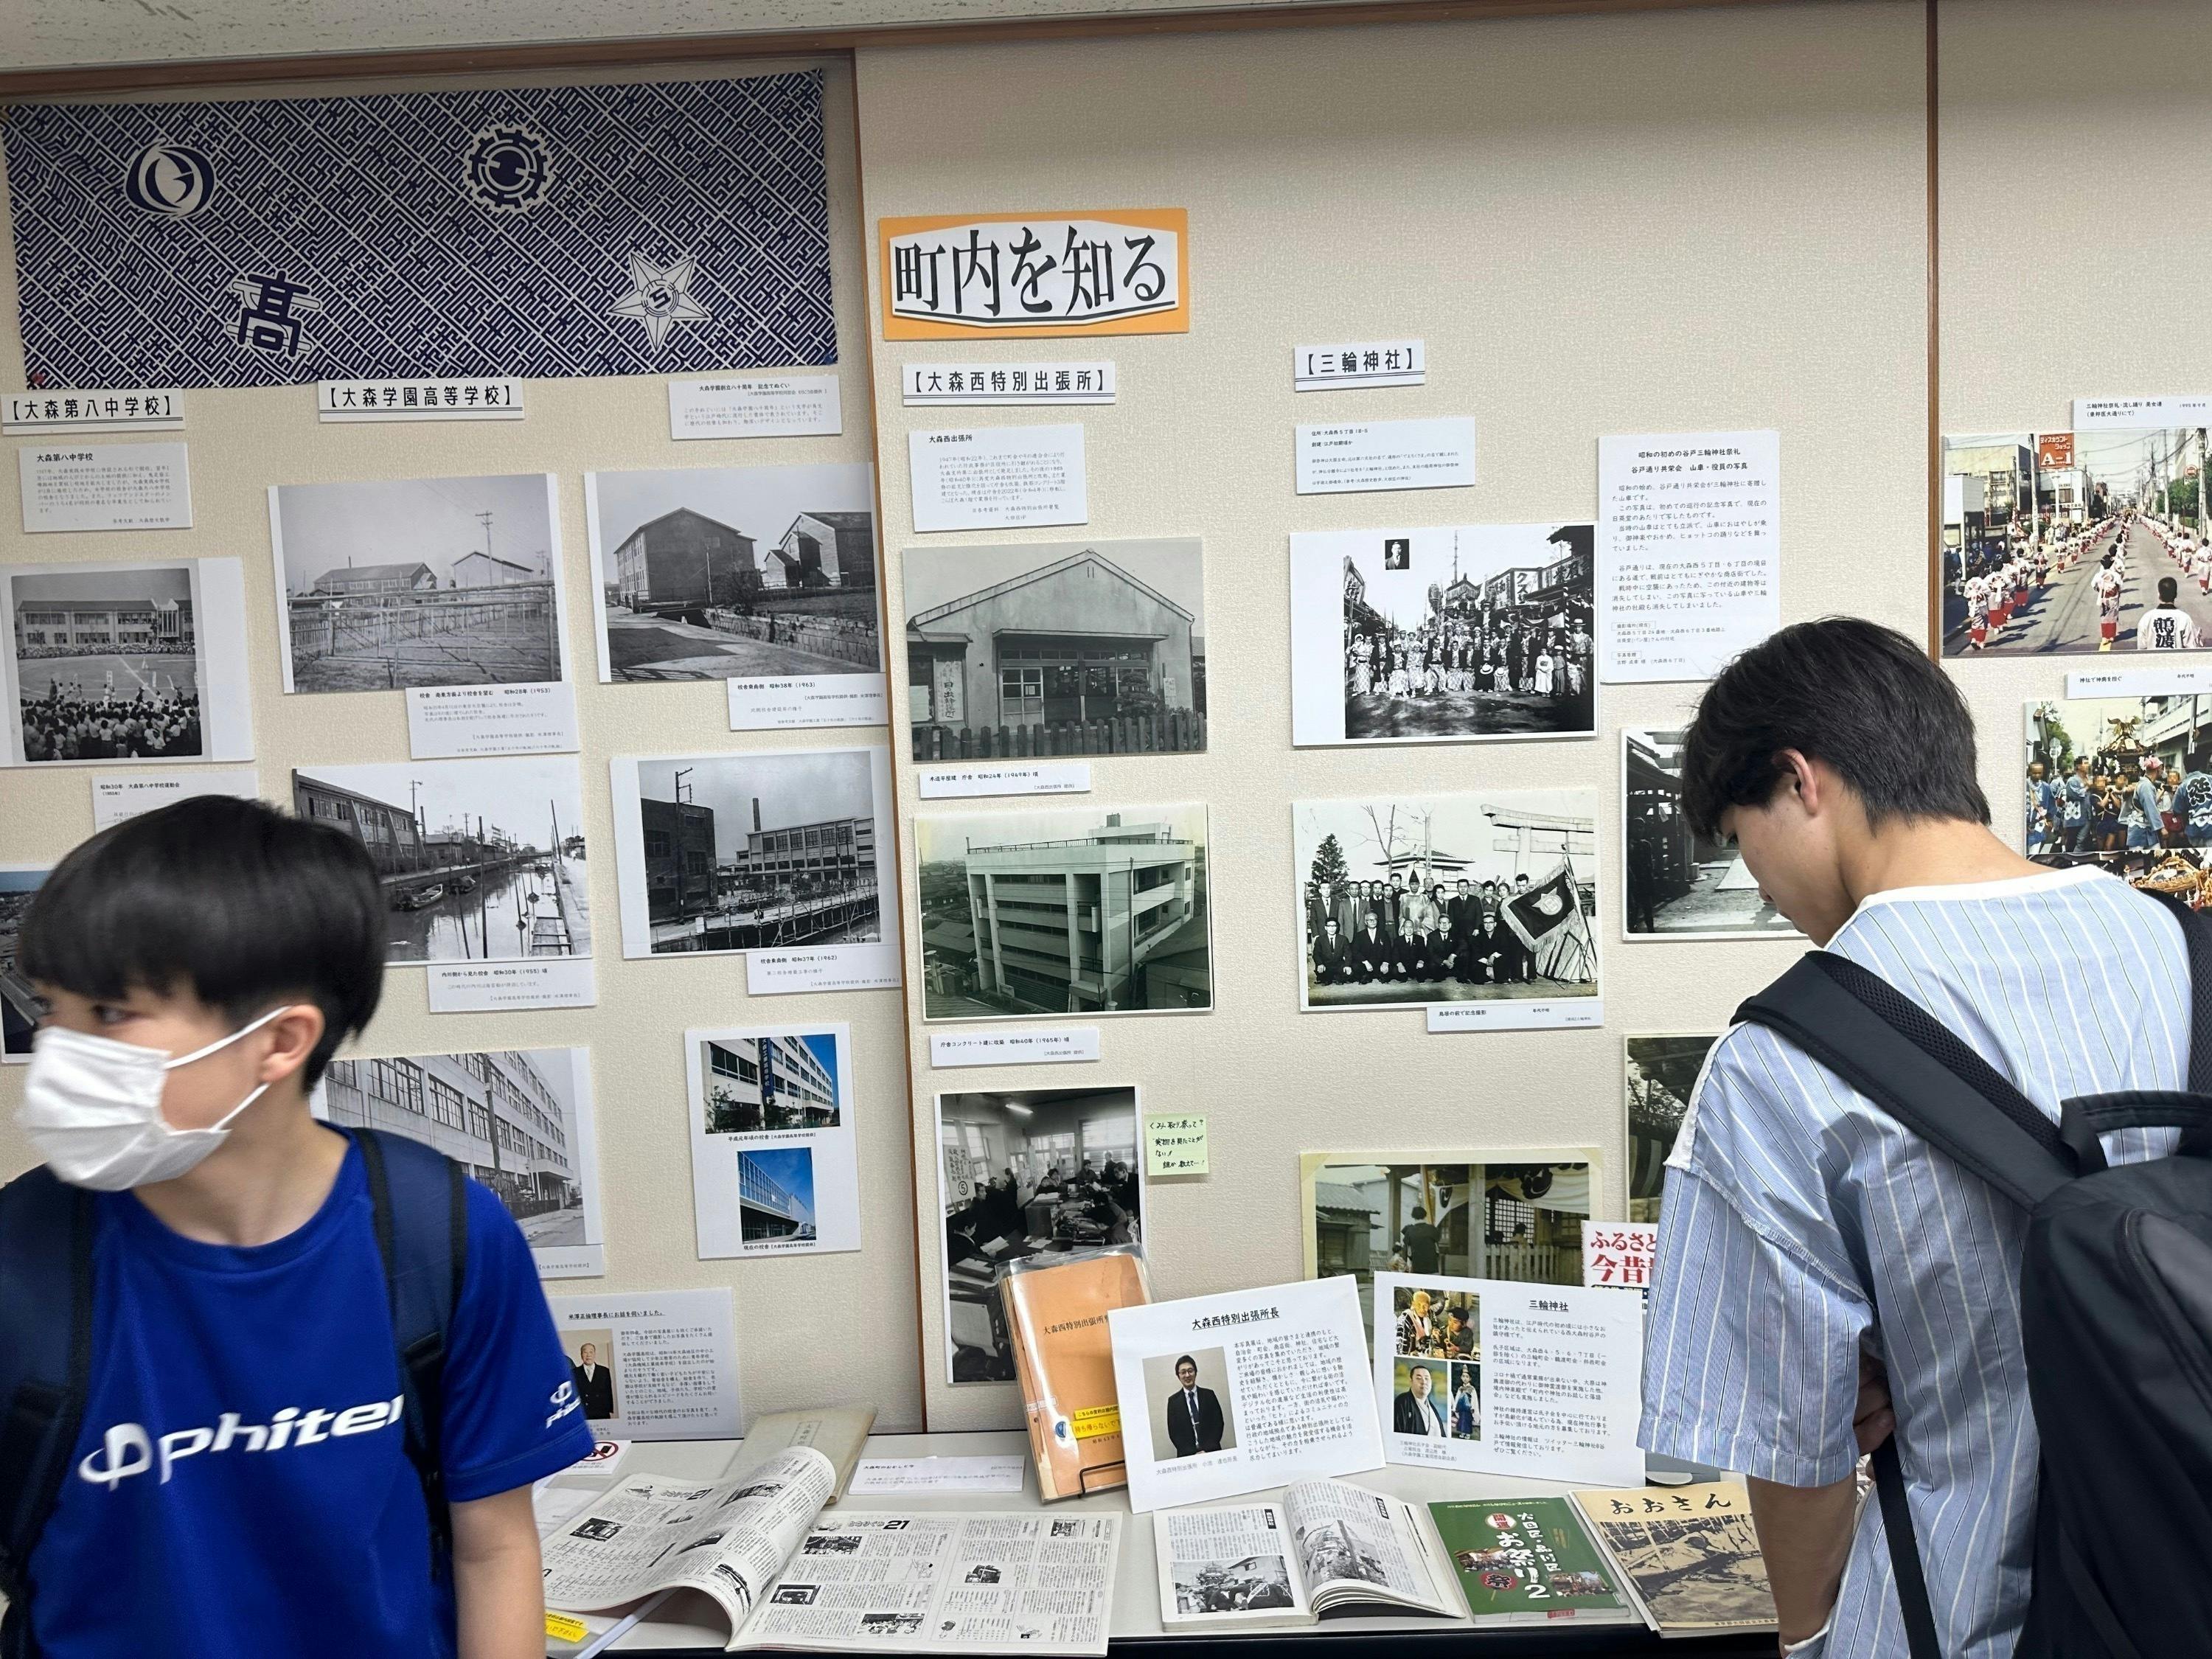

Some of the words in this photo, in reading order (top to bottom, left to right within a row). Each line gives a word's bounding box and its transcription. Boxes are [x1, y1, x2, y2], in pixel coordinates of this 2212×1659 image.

[894, 225, 1166, 317] 町内を知る
[1308, 348, 1412, 375] 【三輪神社】
[915, 369, 1104, 393] 【大森西特別出張所】
[13, 395, 171, 421] 【大森第八中学校】
[331, 385, 512, 408] 【大森学園高等学校】
[929, 434, 973, 444] 大森西出張所
[37, 452, 94, 463] 大森第八中学校
[1638, 448, 1742, 459] 昭和の初めの谷戸三輪神社祭礼
[1631, 465, 1683, 474] 谷戸通り共栄会
[1689, 462, 1748, 472] 山車・役員の写真
[1528, 1300, 1569, 1311] 三輪神社
[1192, 1307, 1280, 1330] 大森西特別出張所長
